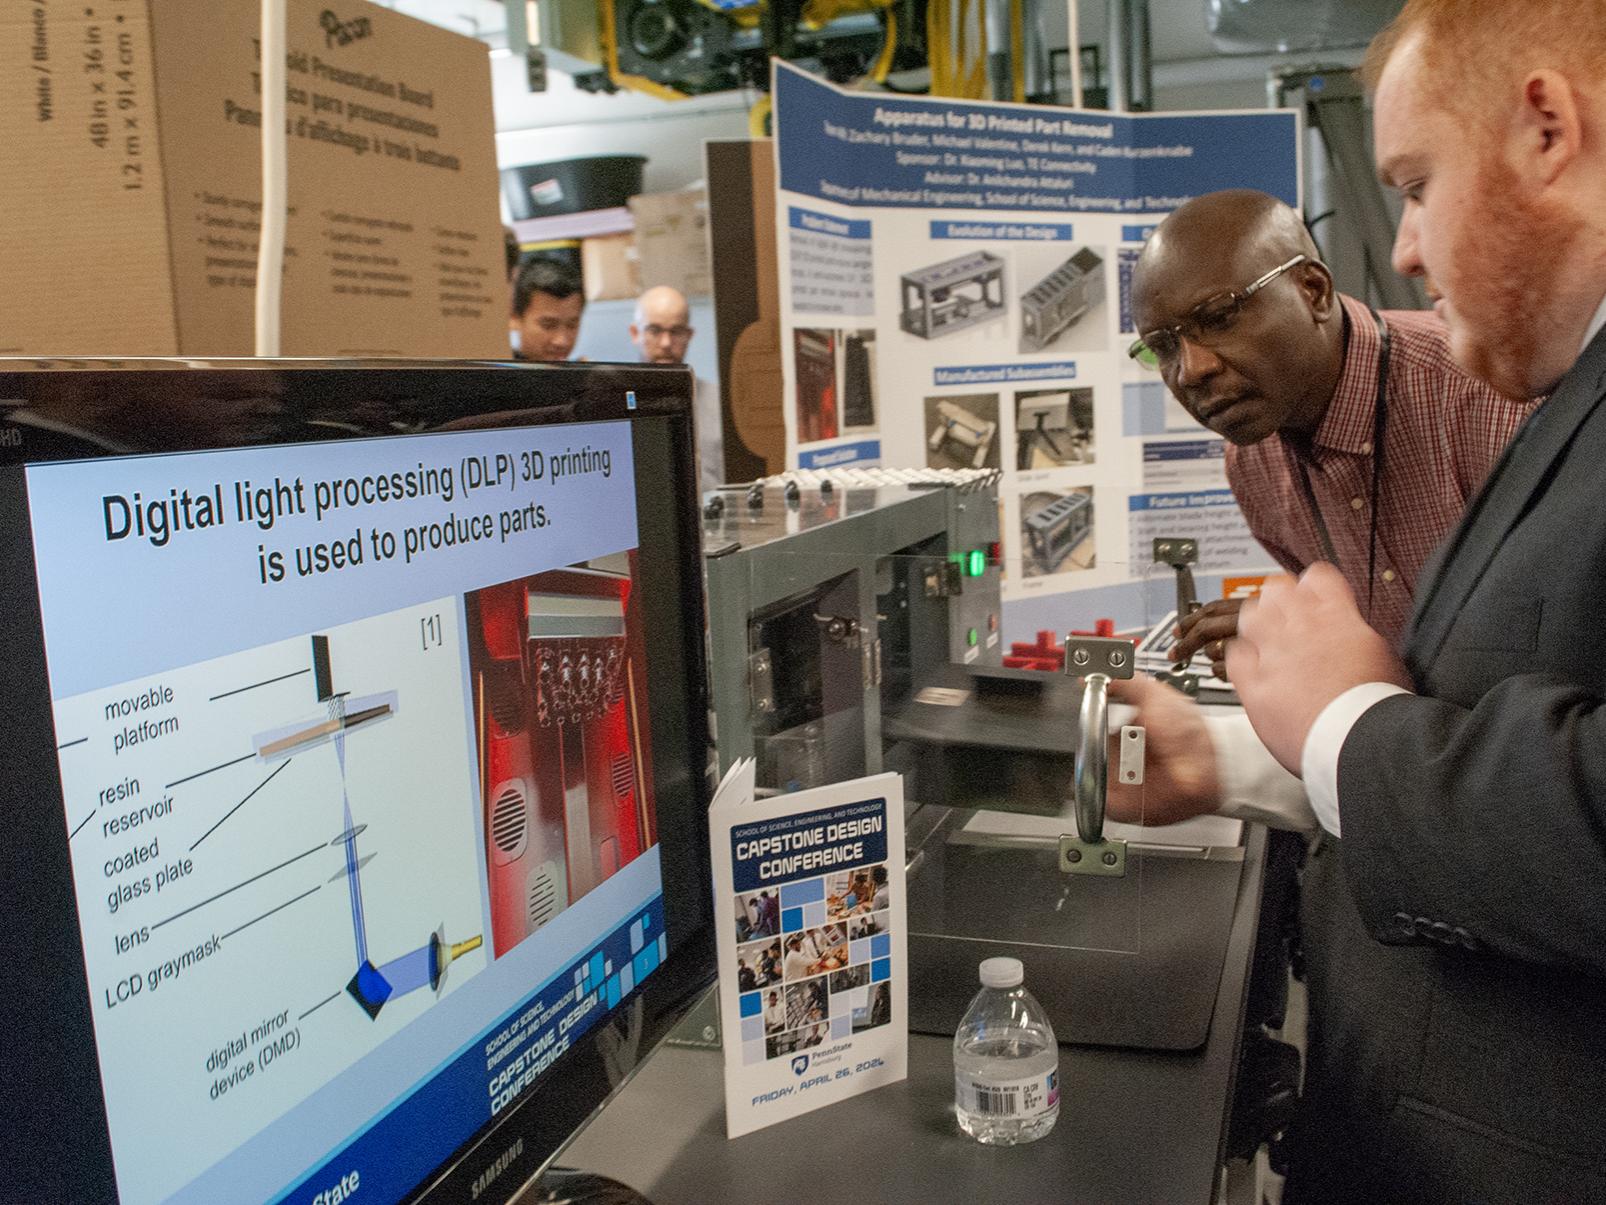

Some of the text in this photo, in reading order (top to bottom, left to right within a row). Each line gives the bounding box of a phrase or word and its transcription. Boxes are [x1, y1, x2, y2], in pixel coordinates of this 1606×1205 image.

[84, 49, 104, 73] 36
[118, 33, 133, 65] cm
[115, 70, 136, 110] 91.4
[90, 122, 109, 148] 48
[873, 107, 1114, 139] Apparatus for 3D Printed Part Removal
[126, 135, 140, 155] m
[122, 163, 142, 190] 1.2
[102, 445, 612, 547] Digital light processing (DLP) 3D printing
[258, 501, 552, 584] is used to produce parts.
[421, 614, 442, 650] [1]
[105, 685, 175, 721] movable
[113, 716, 180, 755] platform
[99, 777, 141, 807] resin
[103, 795, 174, 839] reservoir
[735, 827, 760, 839] SCHOOL
[847, 803, 883, 816] TECHNOLOGY
[104, 836, 160, 878] coated
[736, 815, 882, 861] CAPSTONE DESIGN
[760, 842, 863, 880] CONFERENCE
[107, 858, 194, 914] glass plate
[115, 926, 150, 955] lens
[105, 934, 222, 1009] LCD graymask
[206, 1008, 289, 1073] digital mirror
[485, 1028, 511, 1057] SCHOOL
[510, 1020, 519, 1035] OF
[487, 988, 576, 1071] ENGINEERING AND TECHNOLOGY
[489, 990, 599, 1097] CAPSTONE DESIGN
[210, 1027, 301, 1101] device (DMD)
[812, 1042, 852, 1060] PennState
[491, 1035, 570, 1117] CONFERENCE
[752, 1085, 798, 1107] FRIDAY,
[799, 1074, 832, 1091] APRIL
[471, 1137, 524, 1200] SAMSUNG
